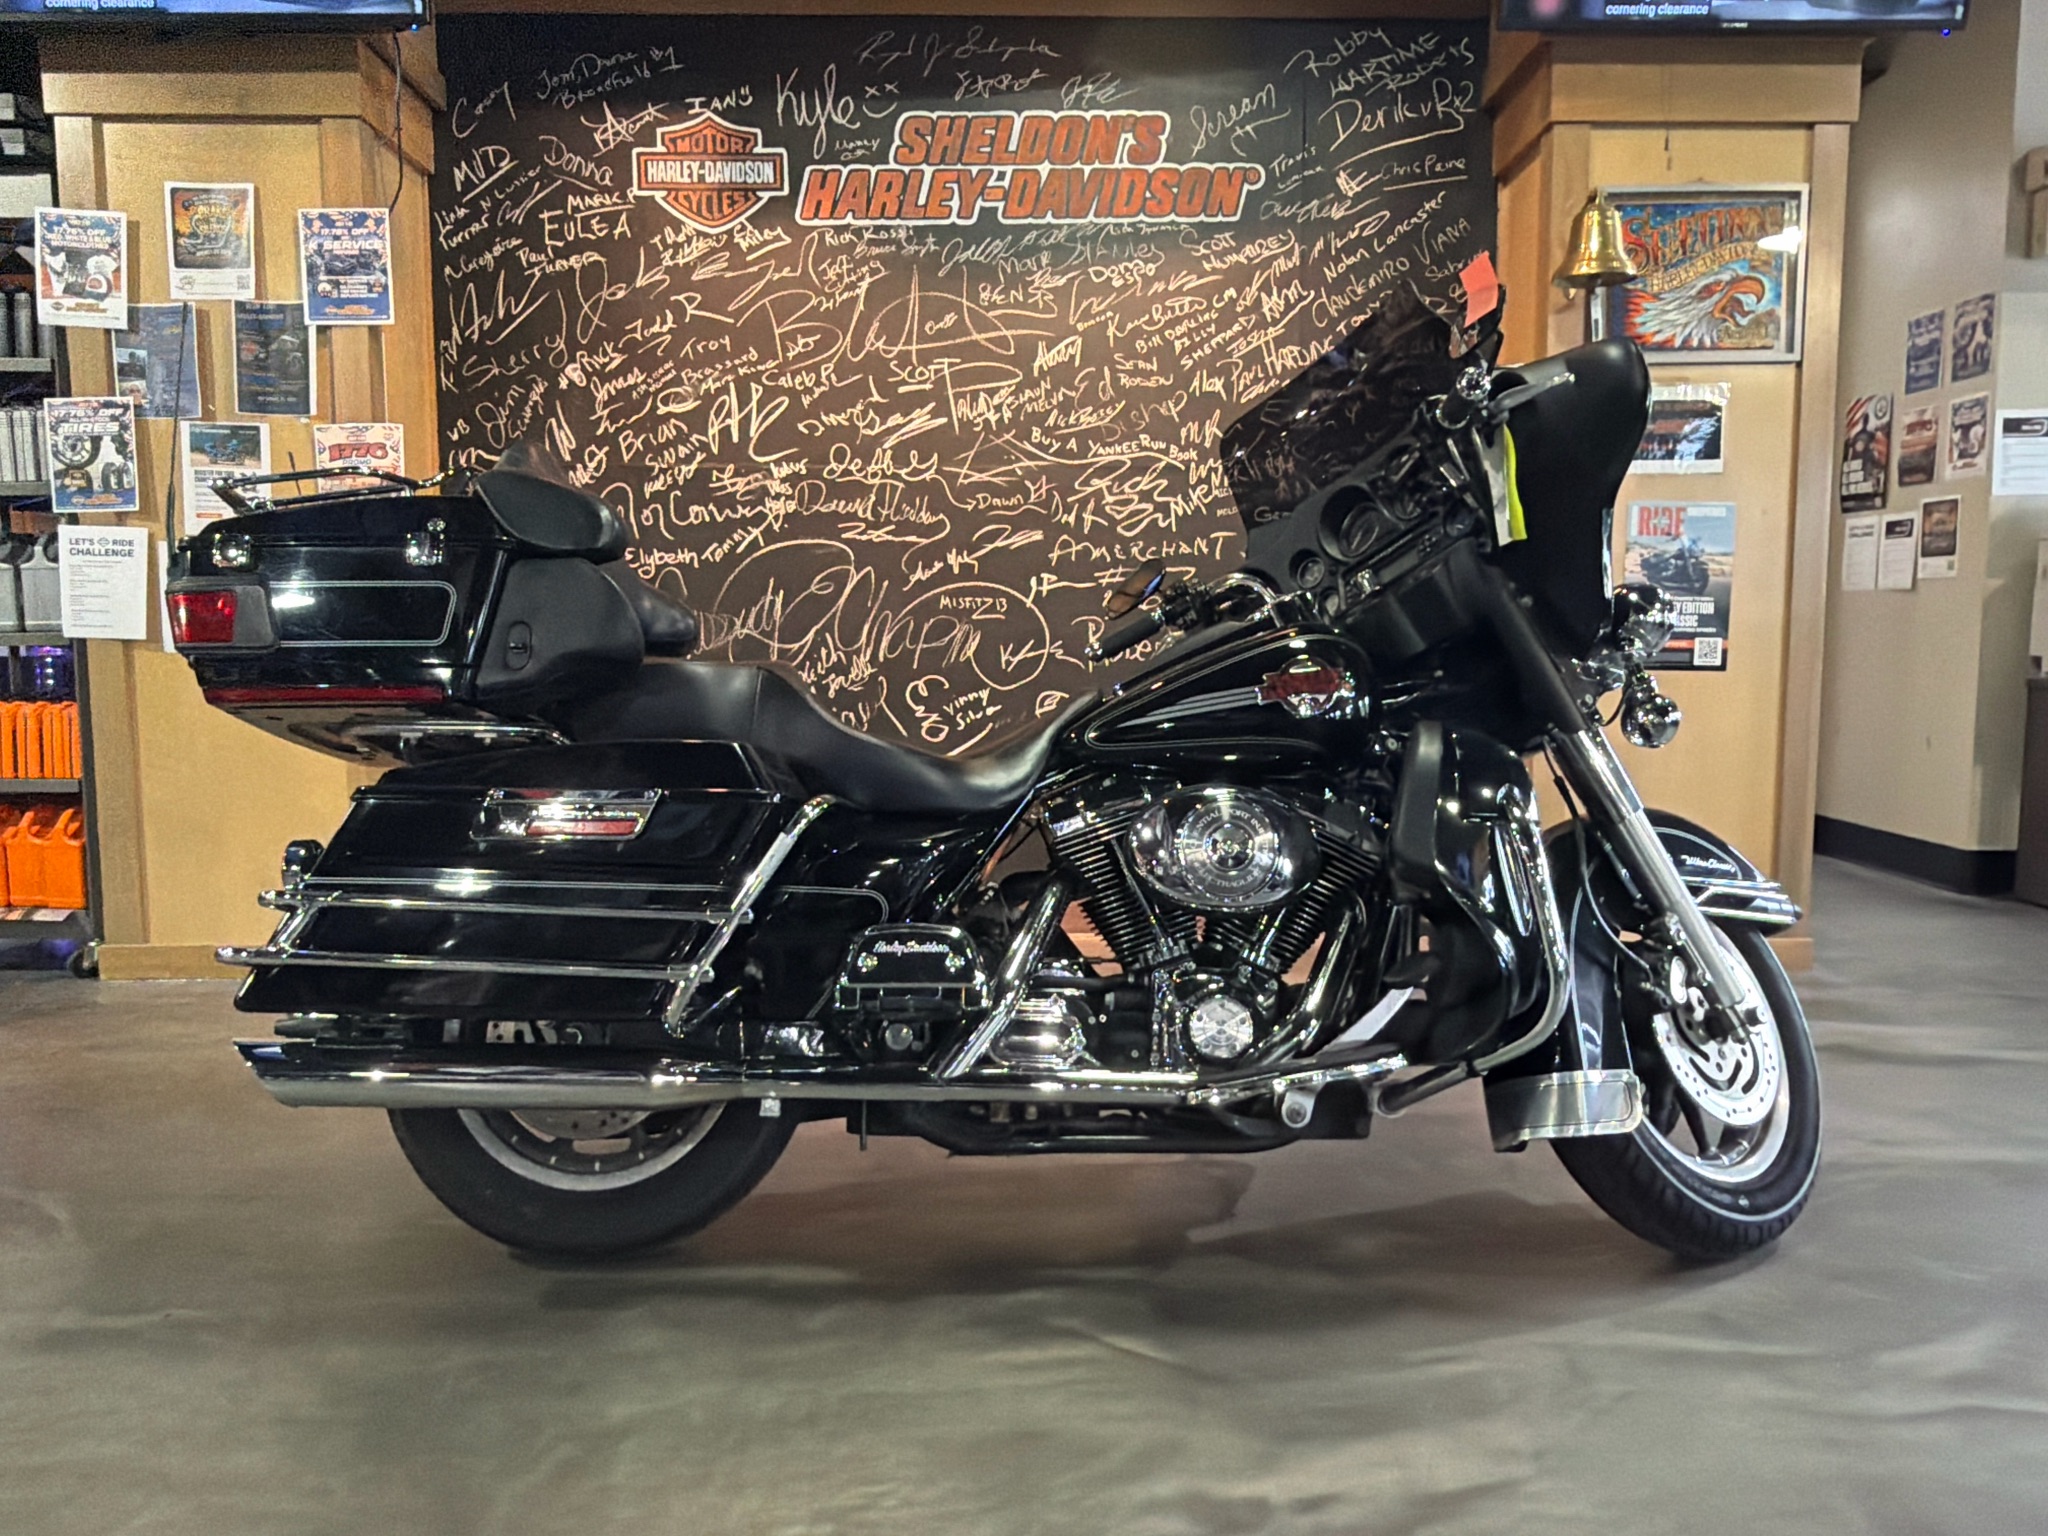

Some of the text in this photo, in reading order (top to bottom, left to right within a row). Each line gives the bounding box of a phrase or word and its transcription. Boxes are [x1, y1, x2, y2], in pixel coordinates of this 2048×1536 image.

[1605, 3, 1709, 17] cornering clearance
[775, 62, 861, 160] Kyle
[897, 114, 1164, 166] SHELDON'S
[646, 159, 776, 184] HARLEY-DAVIDSON
[800, 165, 1247, 221] HARLEY-DAVIDSON
[676, 190, 747, 221] CYCLES
[322, 240, 384, 250] SERVICE
[1322, 247, 1371, 284] Nolan
[1373, 190, 1447, 253] Lancaster
[761, 369, 817, 391] Caleb
[60, 422, 120, 433] TIRES
[328, 442, 389, 463] 1776
[1638, 506, 1686, 536] RIDE
[69, 537, 135, 547] LET'S RIDE
[69, 547, 135, 557] CHALLENGE
[1682, 601, 1715, 615] EDITION
